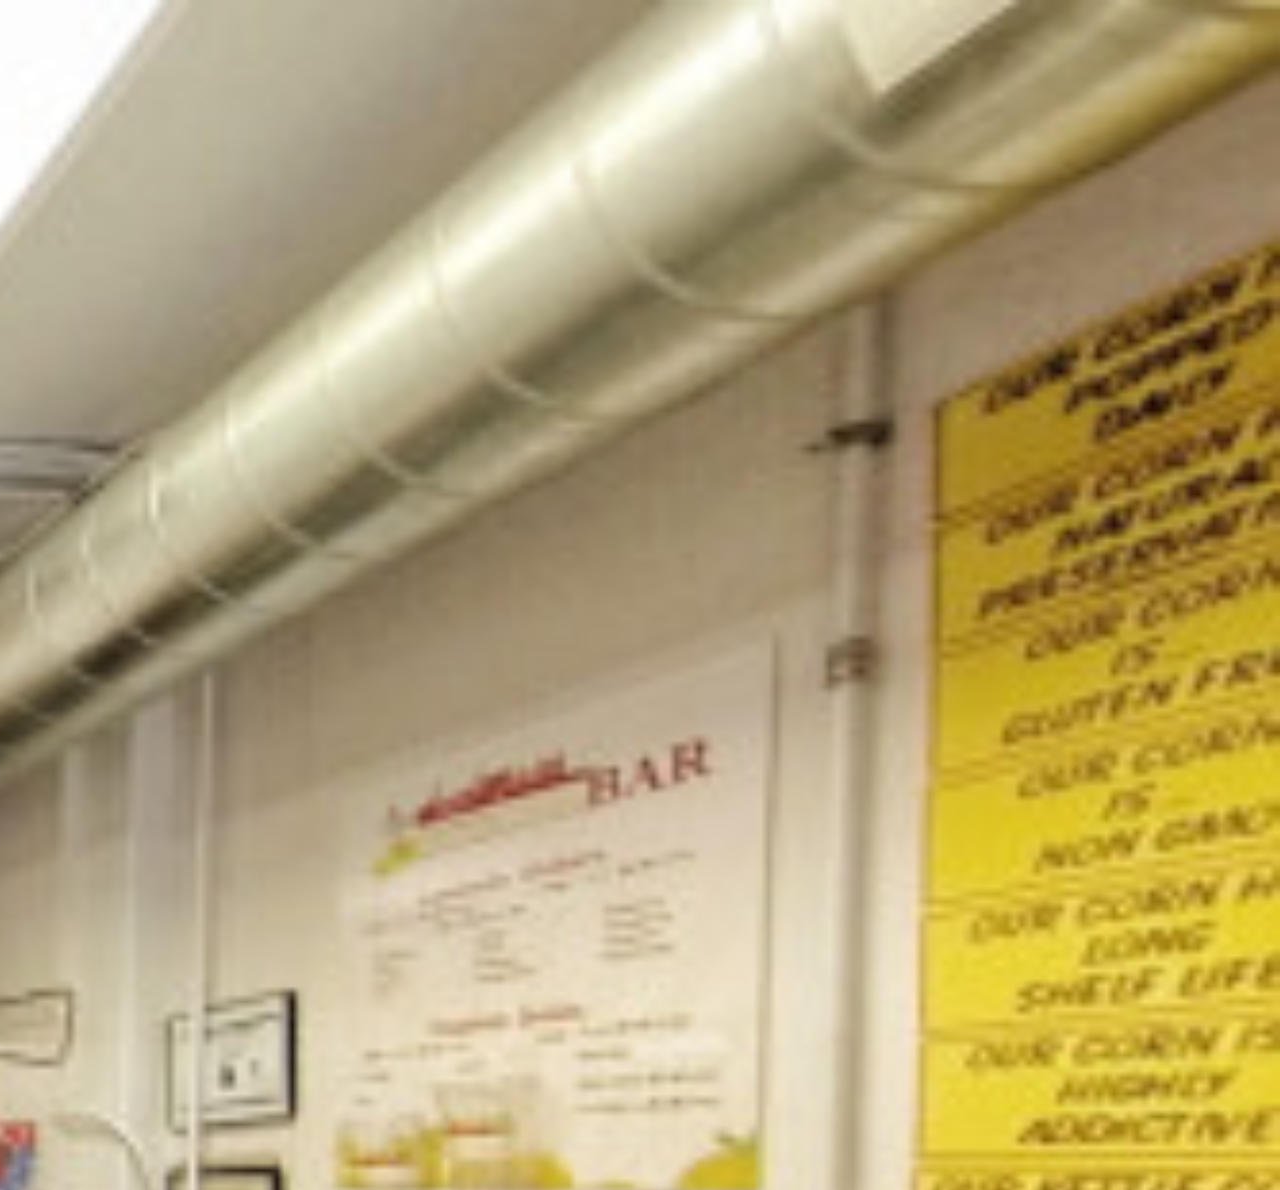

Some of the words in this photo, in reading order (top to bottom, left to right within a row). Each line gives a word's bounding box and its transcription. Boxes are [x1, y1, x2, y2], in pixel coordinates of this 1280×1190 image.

[966, 903, 1065, 945] OUR
[1077, 876, 1218, 928] CORN
[1015, 965, 1166, 1016] SHELF
[964, 1037, 1064, 1072] OUR
[1073, 1024, 1218, 1066] CORN
